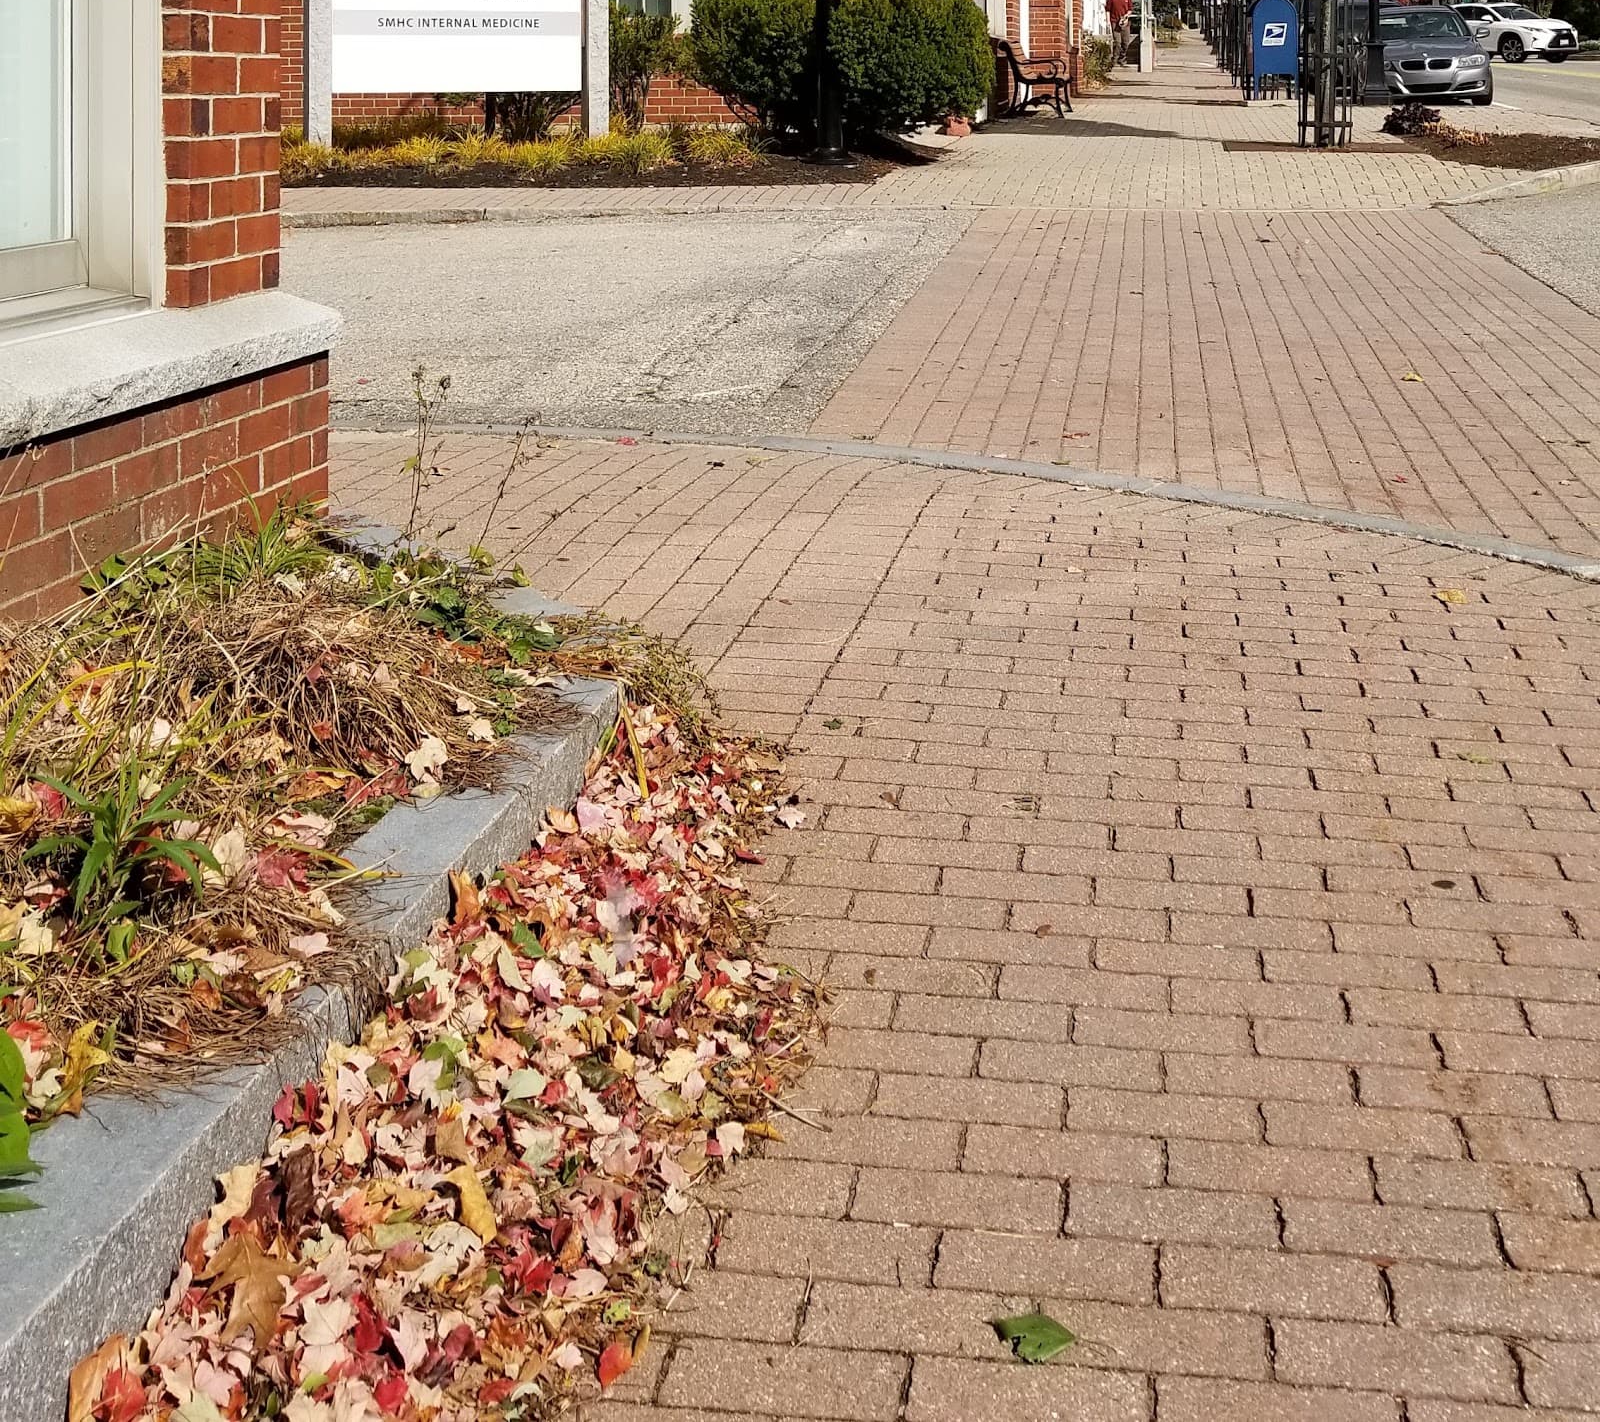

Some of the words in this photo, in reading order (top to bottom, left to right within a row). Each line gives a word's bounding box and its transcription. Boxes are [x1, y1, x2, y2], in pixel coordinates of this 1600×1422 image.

[377, 17, 414, 28] SMHC
[417, 17, 478, 28] INTERNAL
[481, 18, 540, 29] MEDICINE
